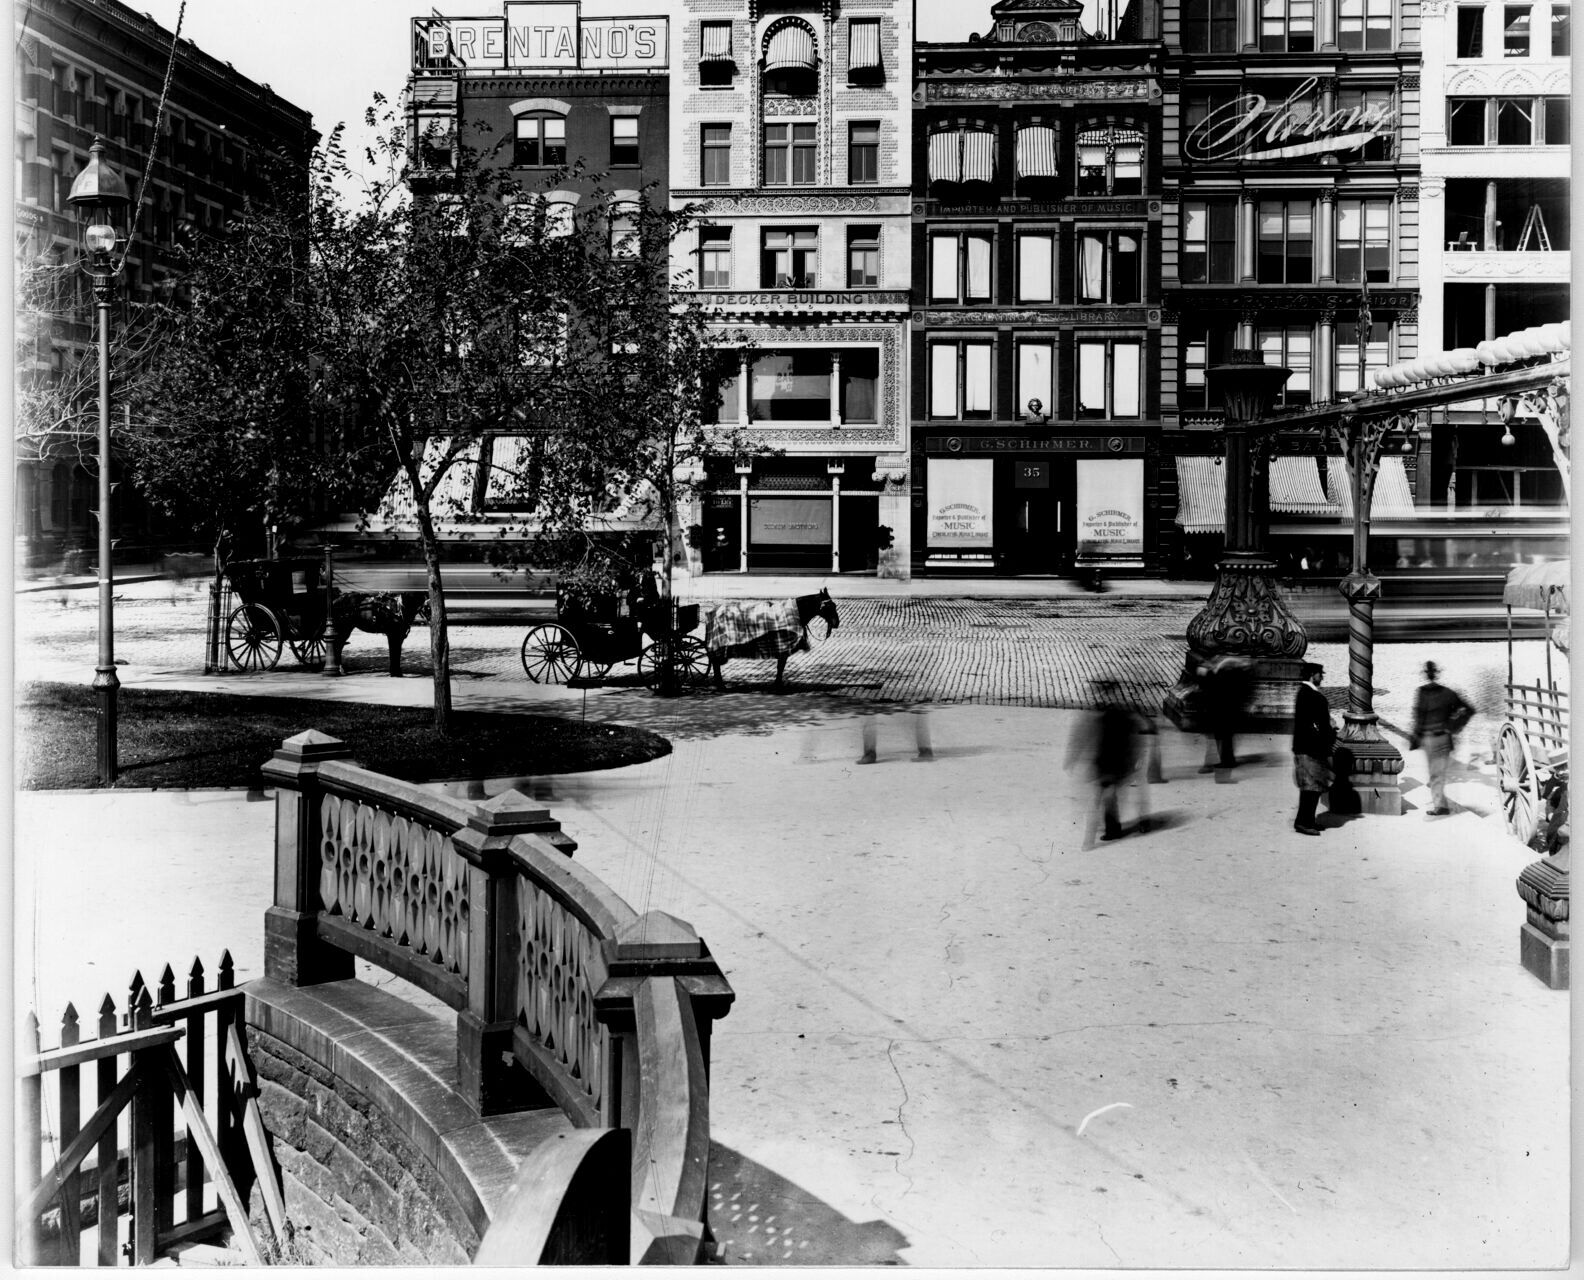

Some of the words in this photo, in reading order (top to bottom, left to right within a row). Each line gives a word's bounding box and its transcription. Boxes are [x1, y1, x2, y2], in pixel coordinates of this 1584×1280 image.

[427, 23, 656, 59] BRENTANO'S
[940, 205, 994, 214] IMPORTER
[997, 204, 1016, 214] AND
[1020, 204, 1076, 213] PUBLISHER
[1081, 204, 1095, 213] OF
[1096, 204, 1132, 213] MUSIC
[715, 294, 781, 305] DECKER
[787, 293, 864, 305] BUILDING
[1023, 466, 1041, 478] 35
[944, 522, 976, 530] MUSIC
[1093, 528, 1126, 537] MUSIC
